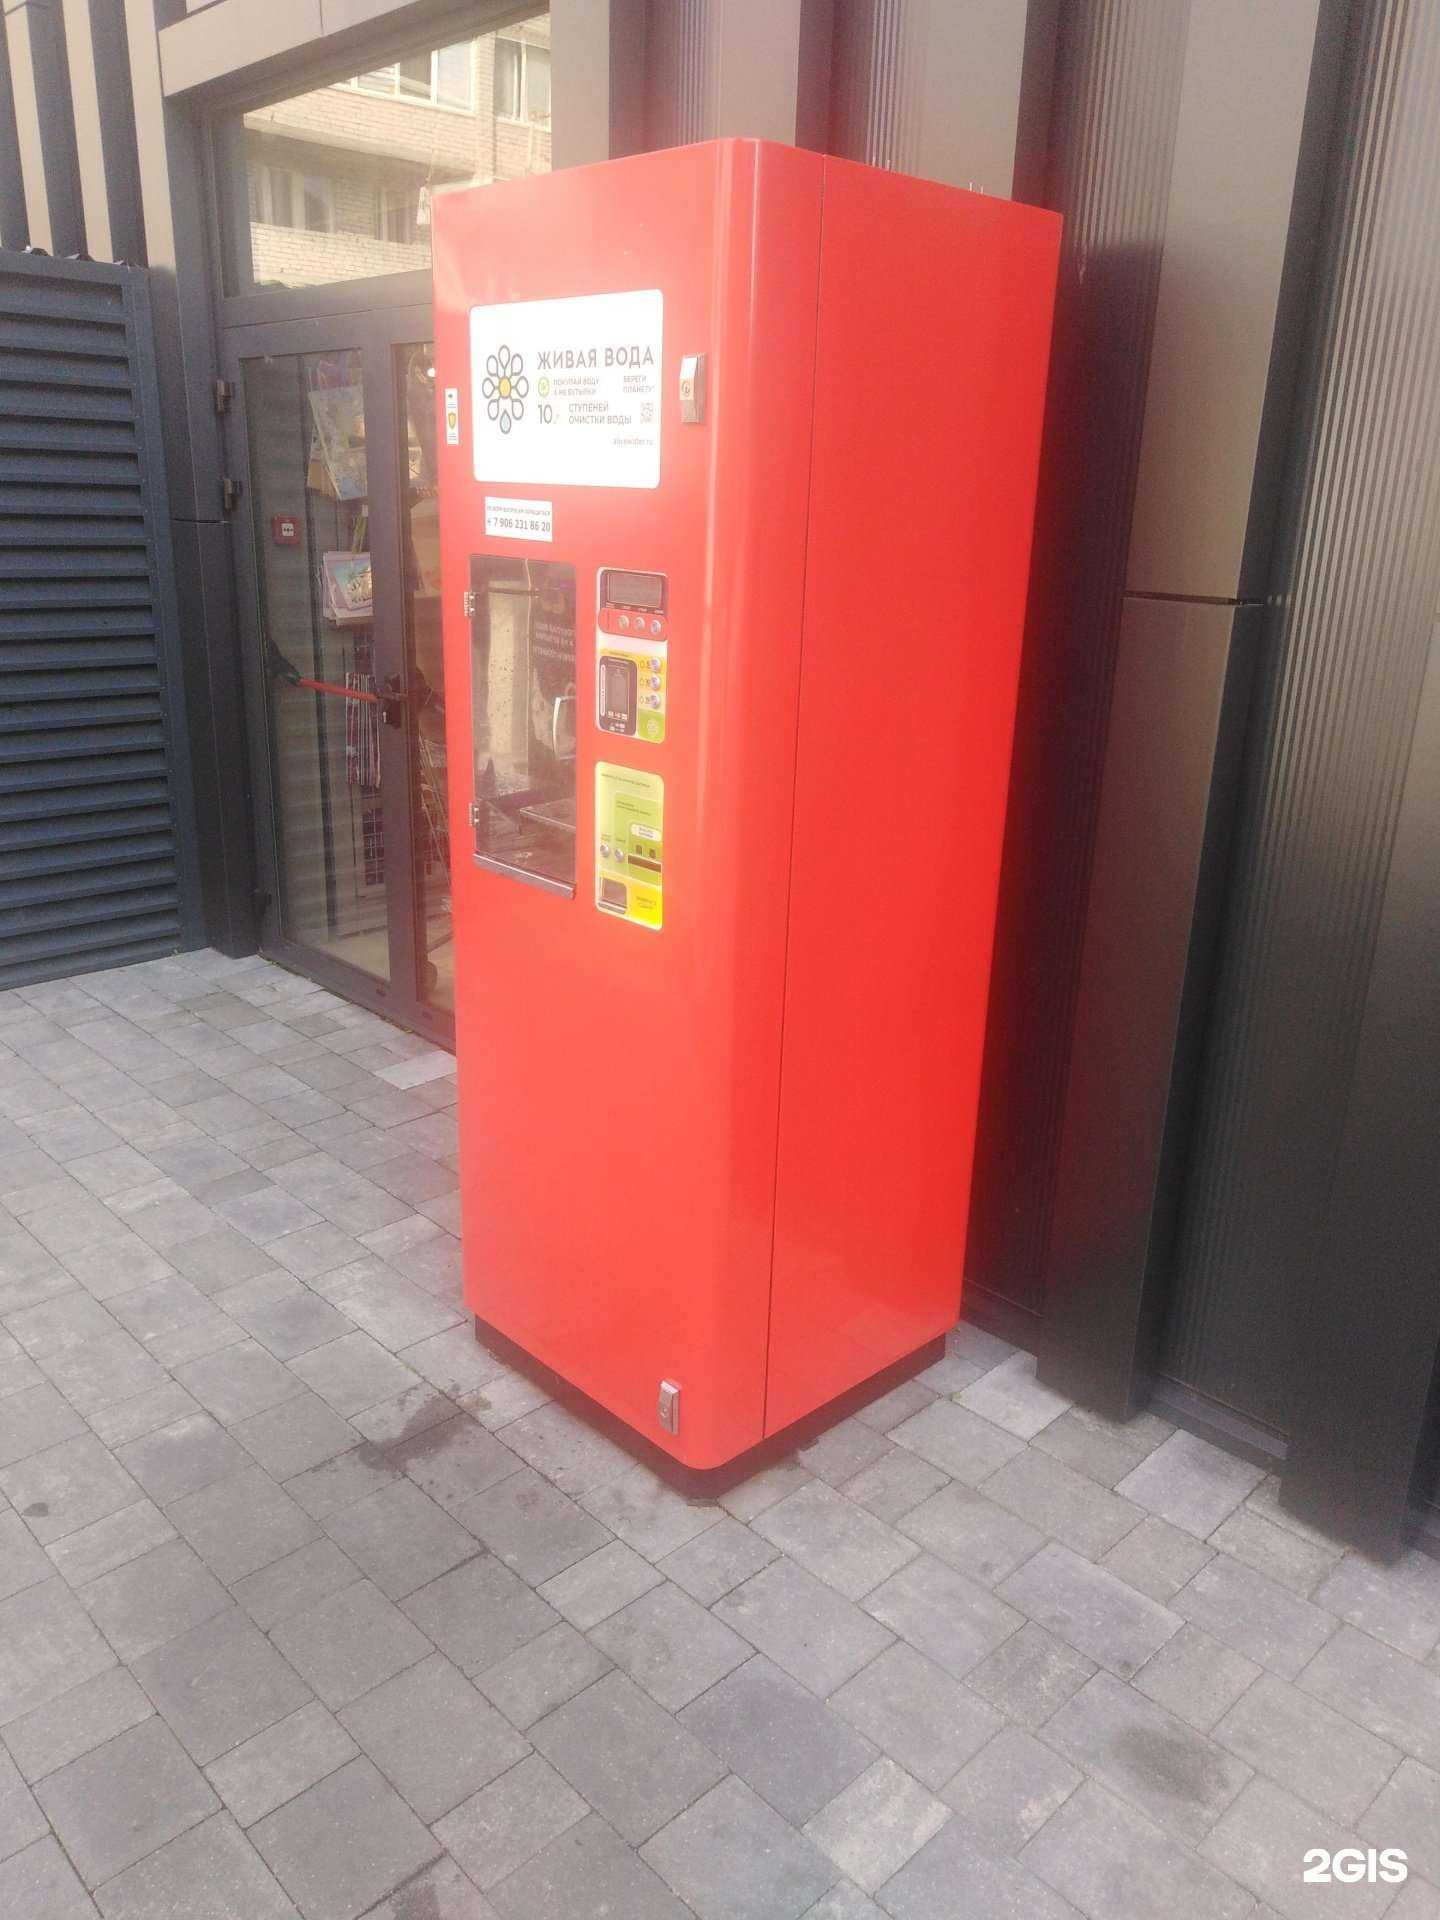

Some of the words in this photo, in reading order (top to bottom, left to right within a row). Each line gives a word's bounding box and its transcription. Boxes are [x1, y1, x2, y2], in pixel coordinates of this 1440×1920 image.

[537, 348, 597, 370] ЖИВАЯ
[604, 346, 654, 368] ВОДА
[537, 404, 553, 424] 10
[568, 401, 609, 413] СТУПЕНЕЙ
[568, 415, 605, 424] ОЧИСТКИ
[607, 415, 632, 426] ВОДЫ
[494, 517, 499, 528] 7
[499, 517, 513, 528] 906
[515, 519, 529, 530] 231
[530, 520, 540, 531] 86
[541, 521, 551, 532] 20
